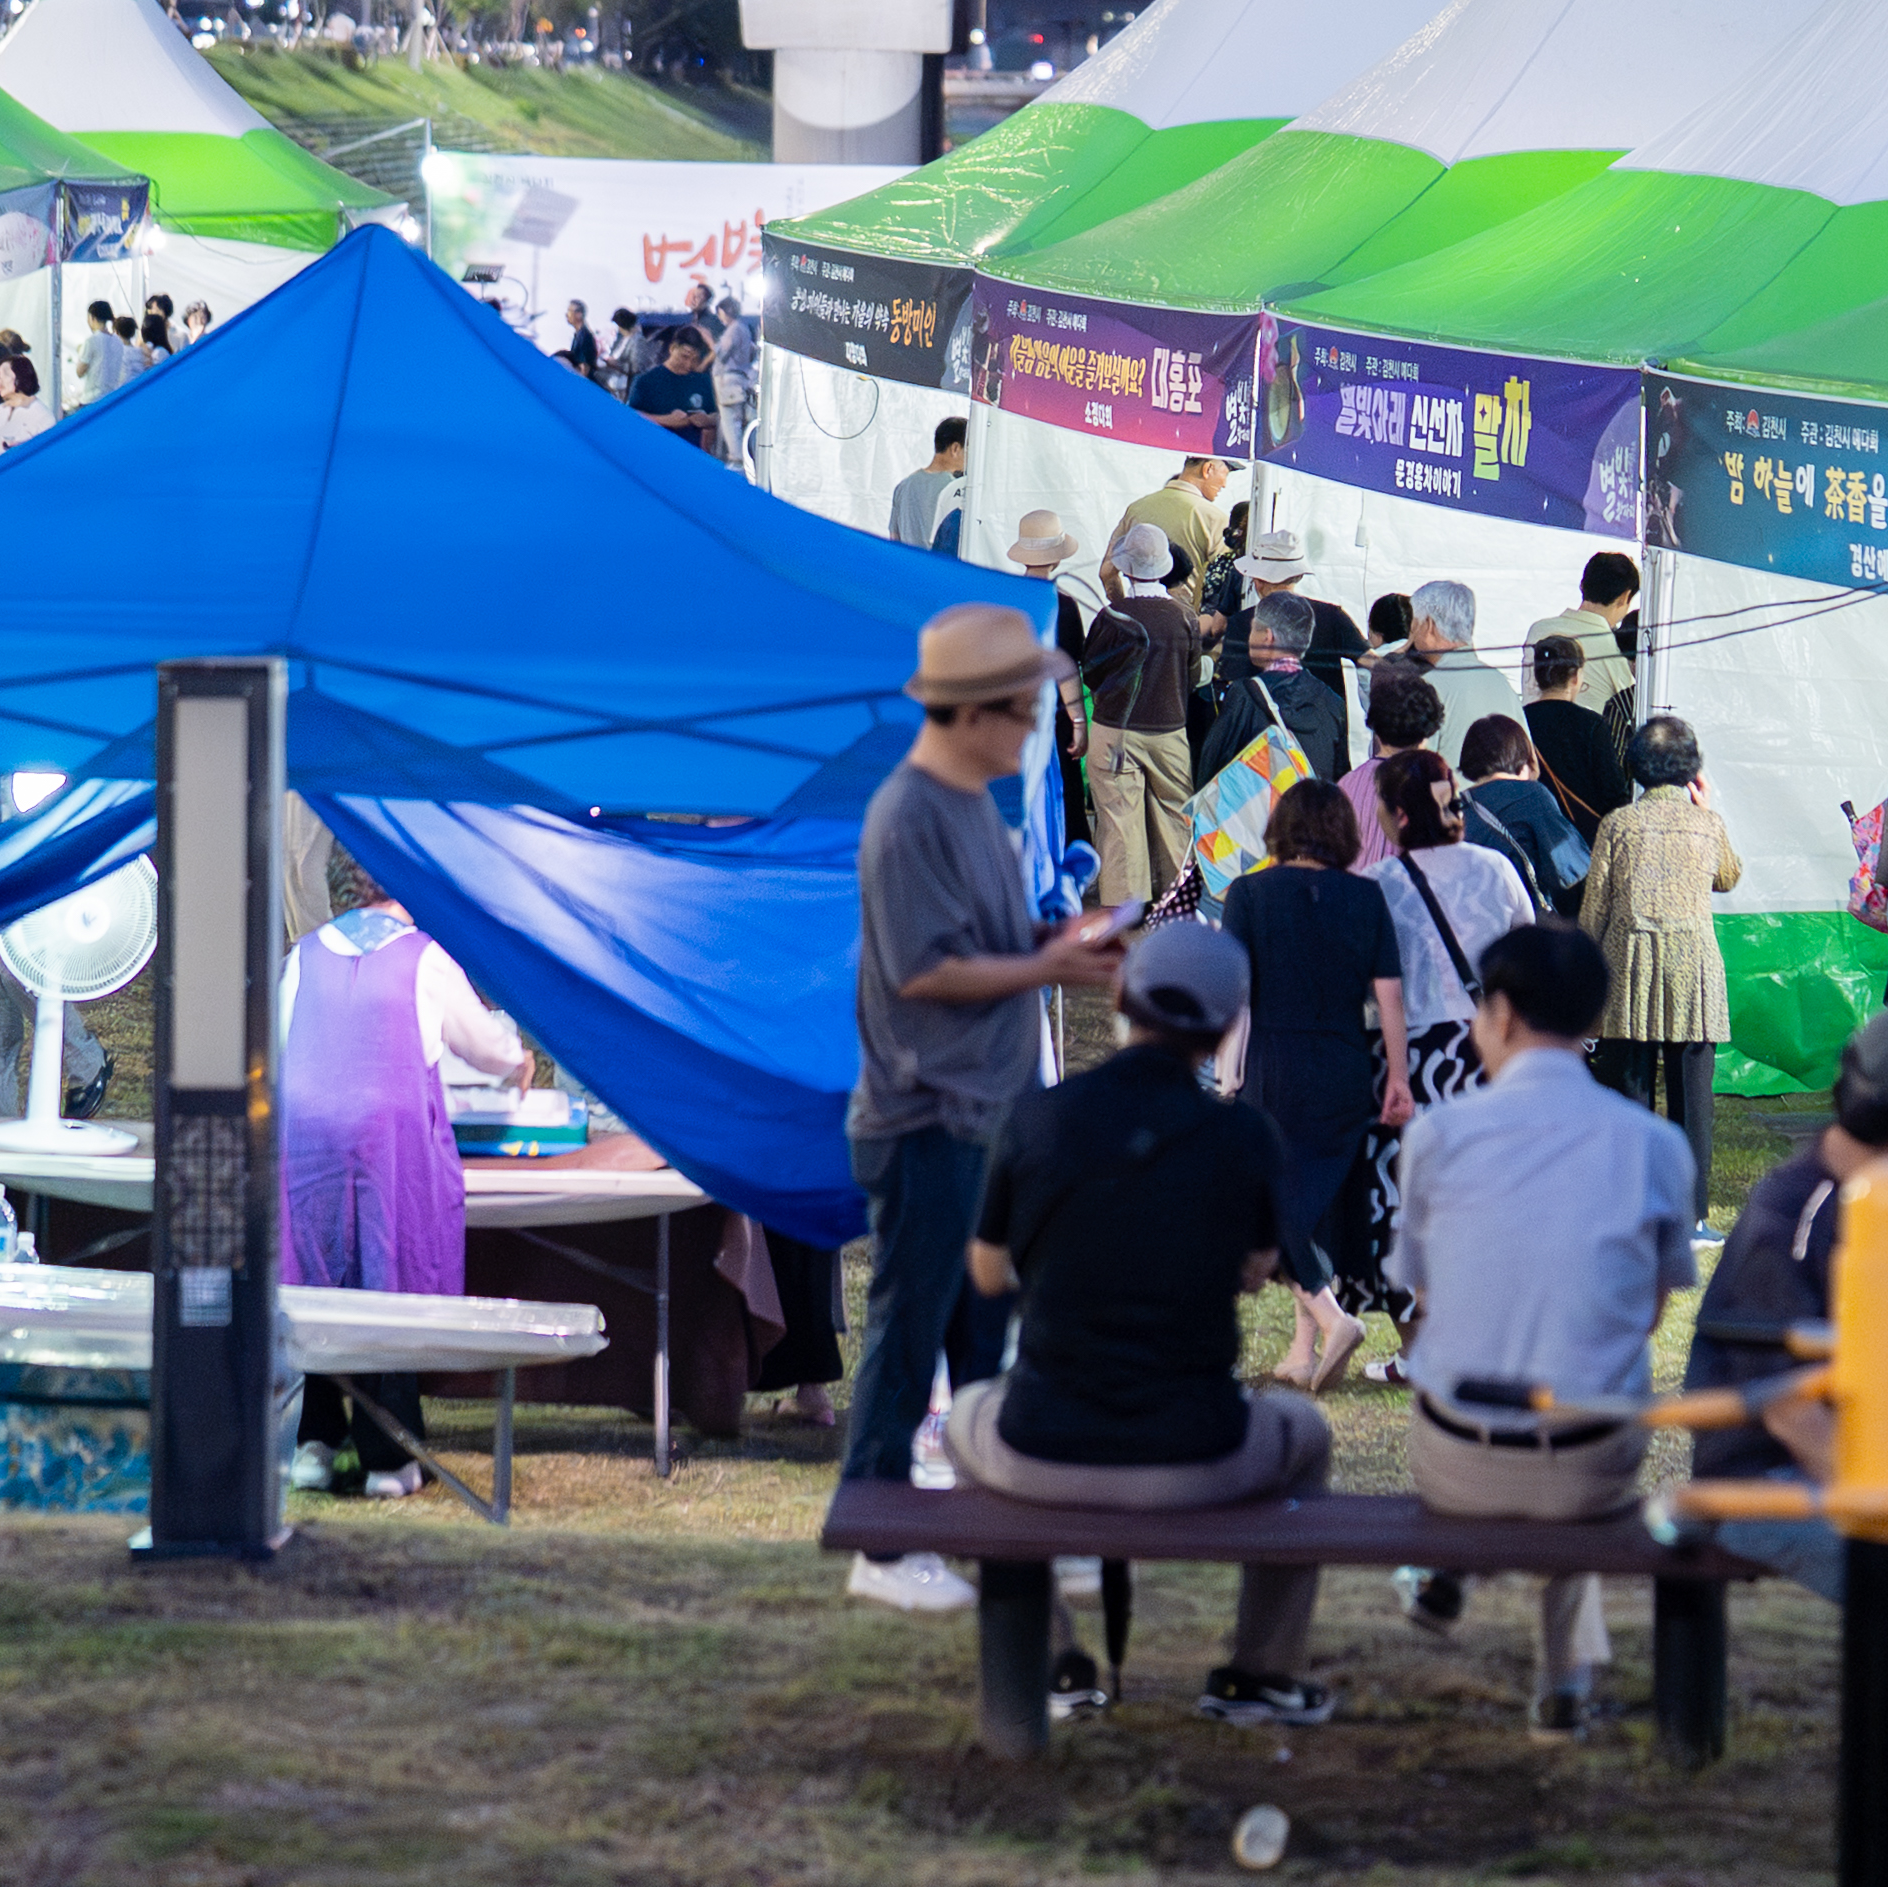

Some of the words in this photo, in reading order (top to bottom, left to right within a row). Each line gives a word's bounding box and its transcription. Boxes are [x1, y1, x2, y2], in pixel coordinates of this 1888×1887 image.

[890, 298, 936, 348] 동방미인
[1151, 347, 1204, 414] 대홍포
[1409, 394, 1463, 458] 신선차
[1473, 375, 1532, 481] 말차
[1762, 415, 1787, 441] 김천시
[1825, 423, 1851, 450] 김천시
[1852, 427, 1879, 454] 예다회
[1395, 458, 1461, 499] 문경홍차이야기
[1723, 451, 1744, 505] 밤
[1753, 455, 1815, 513] 하늘에
[1824, 465, 1888, 530] 茶香을
